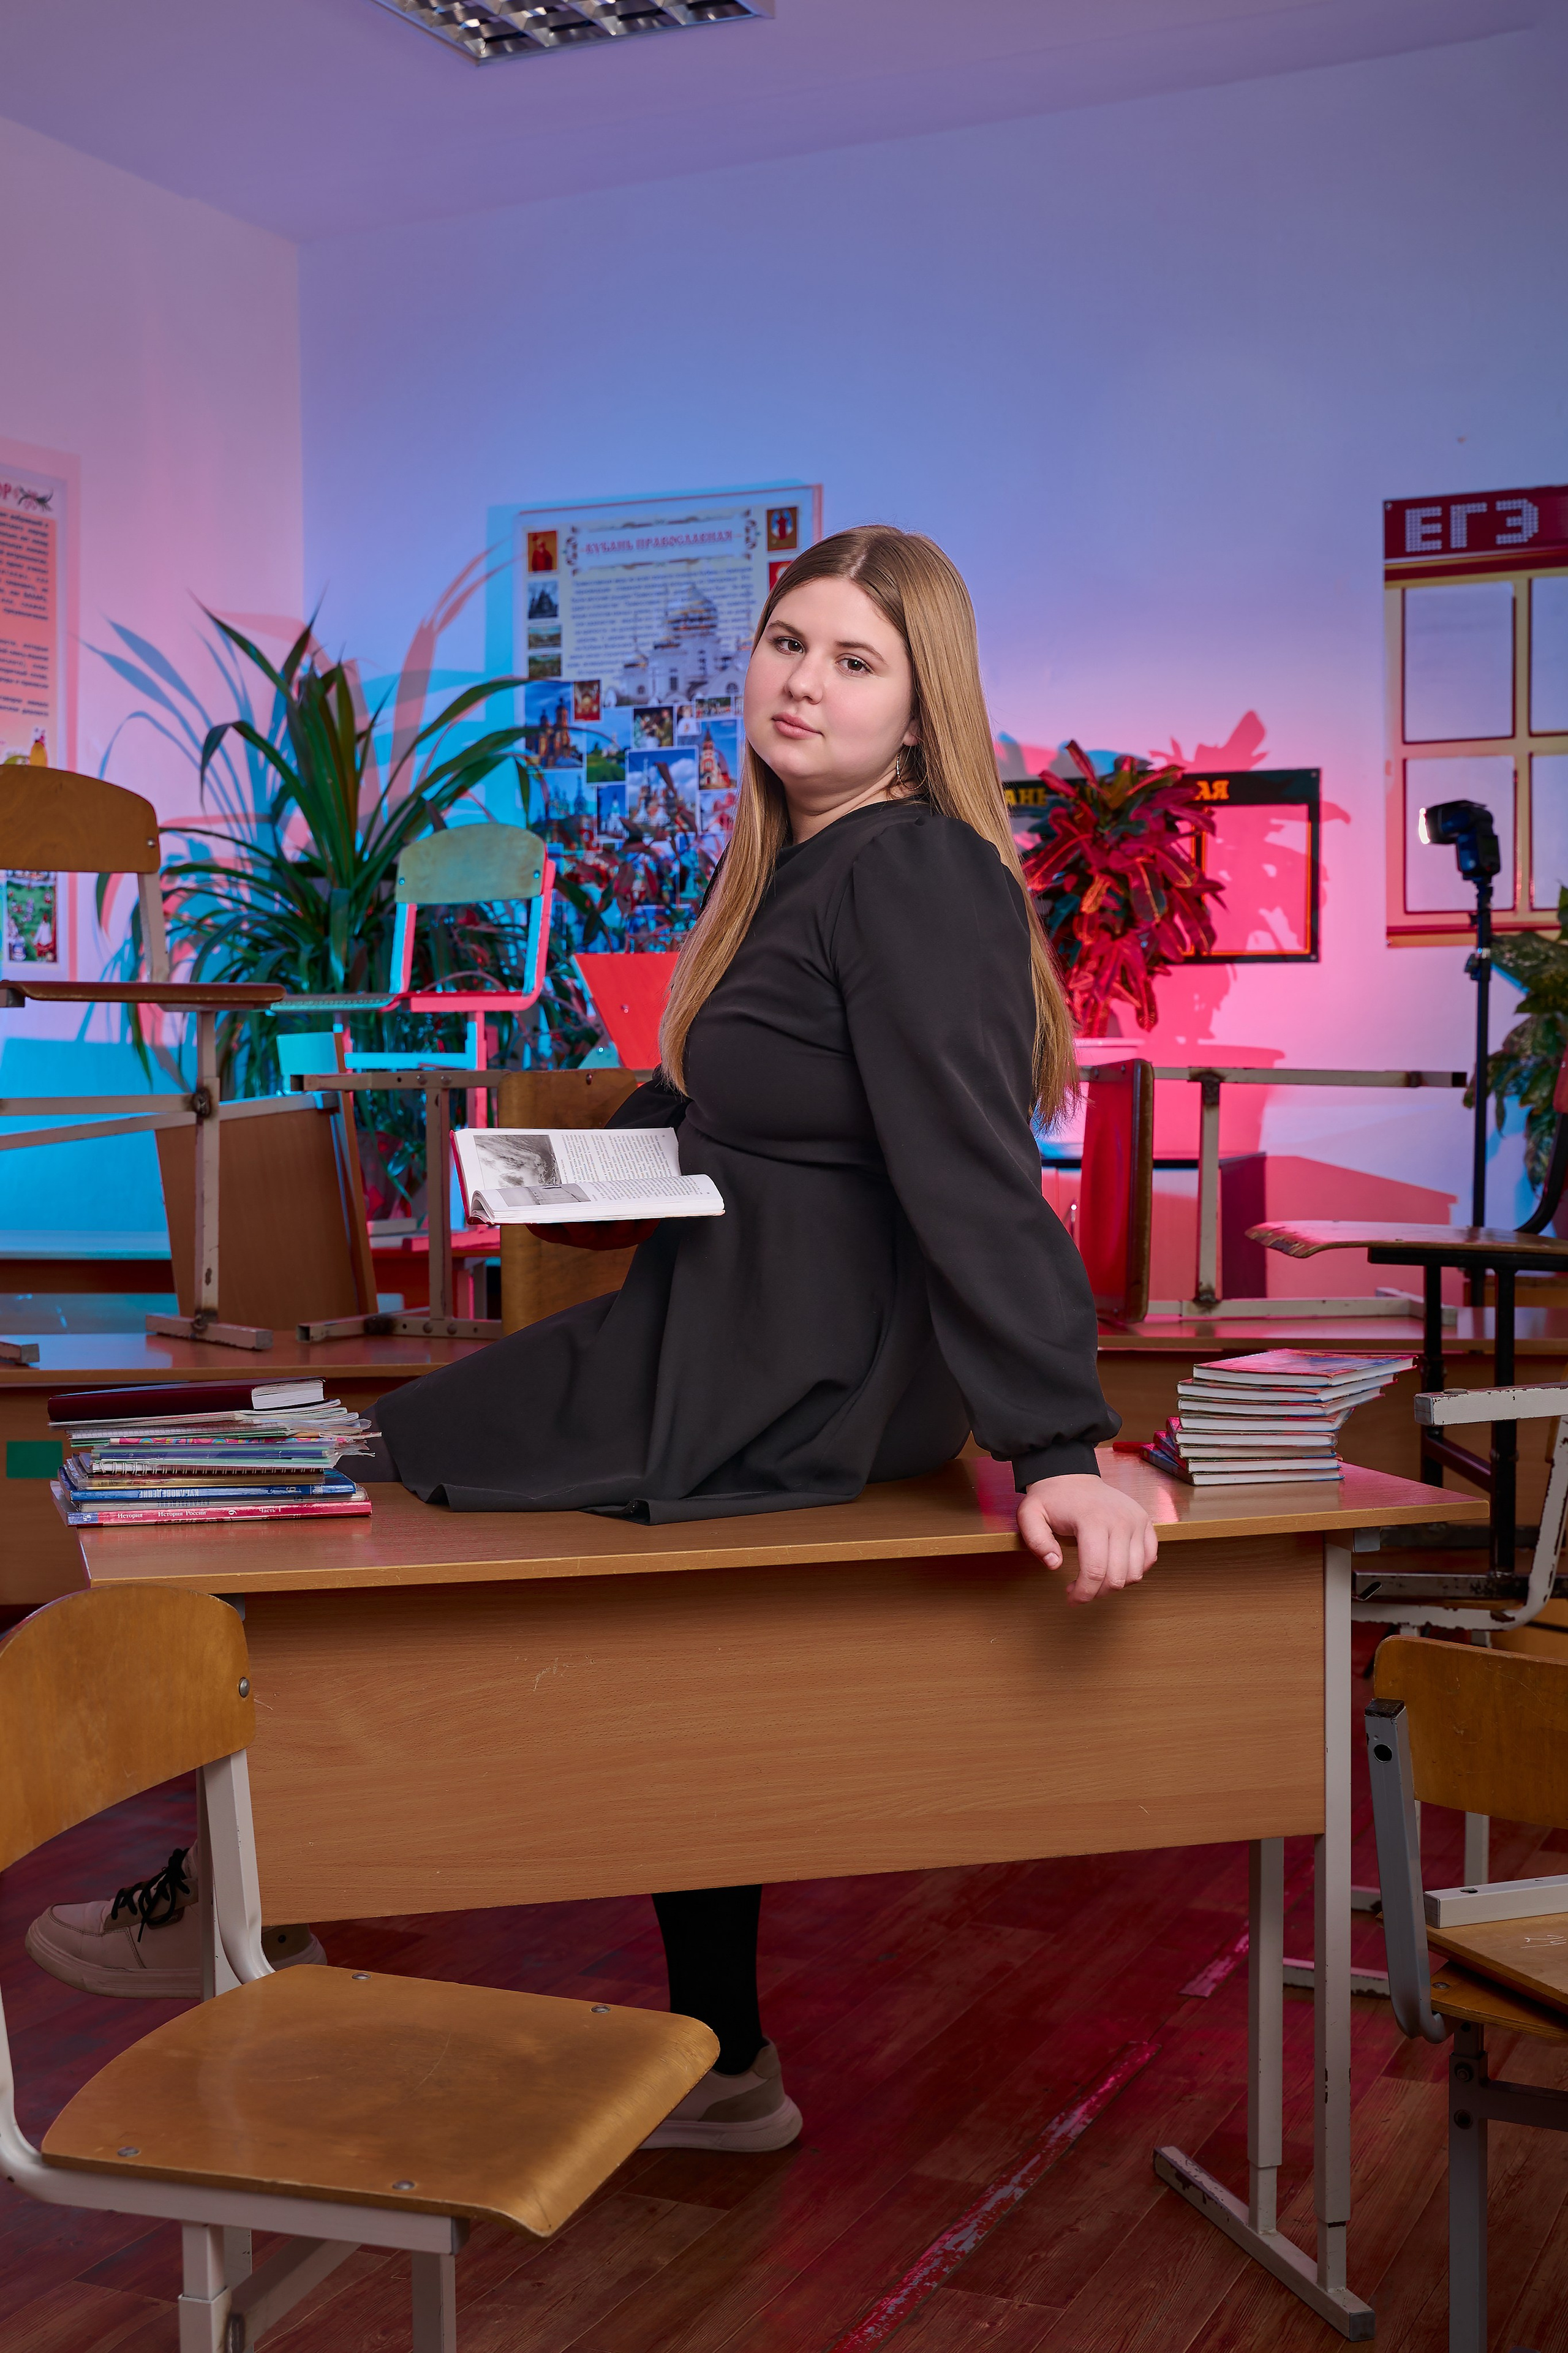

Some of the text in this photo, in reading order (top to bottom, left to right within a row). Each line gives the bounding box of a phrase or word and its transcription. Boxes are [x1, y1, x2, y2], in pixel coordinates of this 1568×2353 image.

[1404, 498, 1539, 552] ЕГЭ
[585, 529, 733, 556] КУБАНЬ ПРАВОСЛАВНАЯ
[138, 1488, 199, 1499] КУБАНОВЕДЕНИЕ
